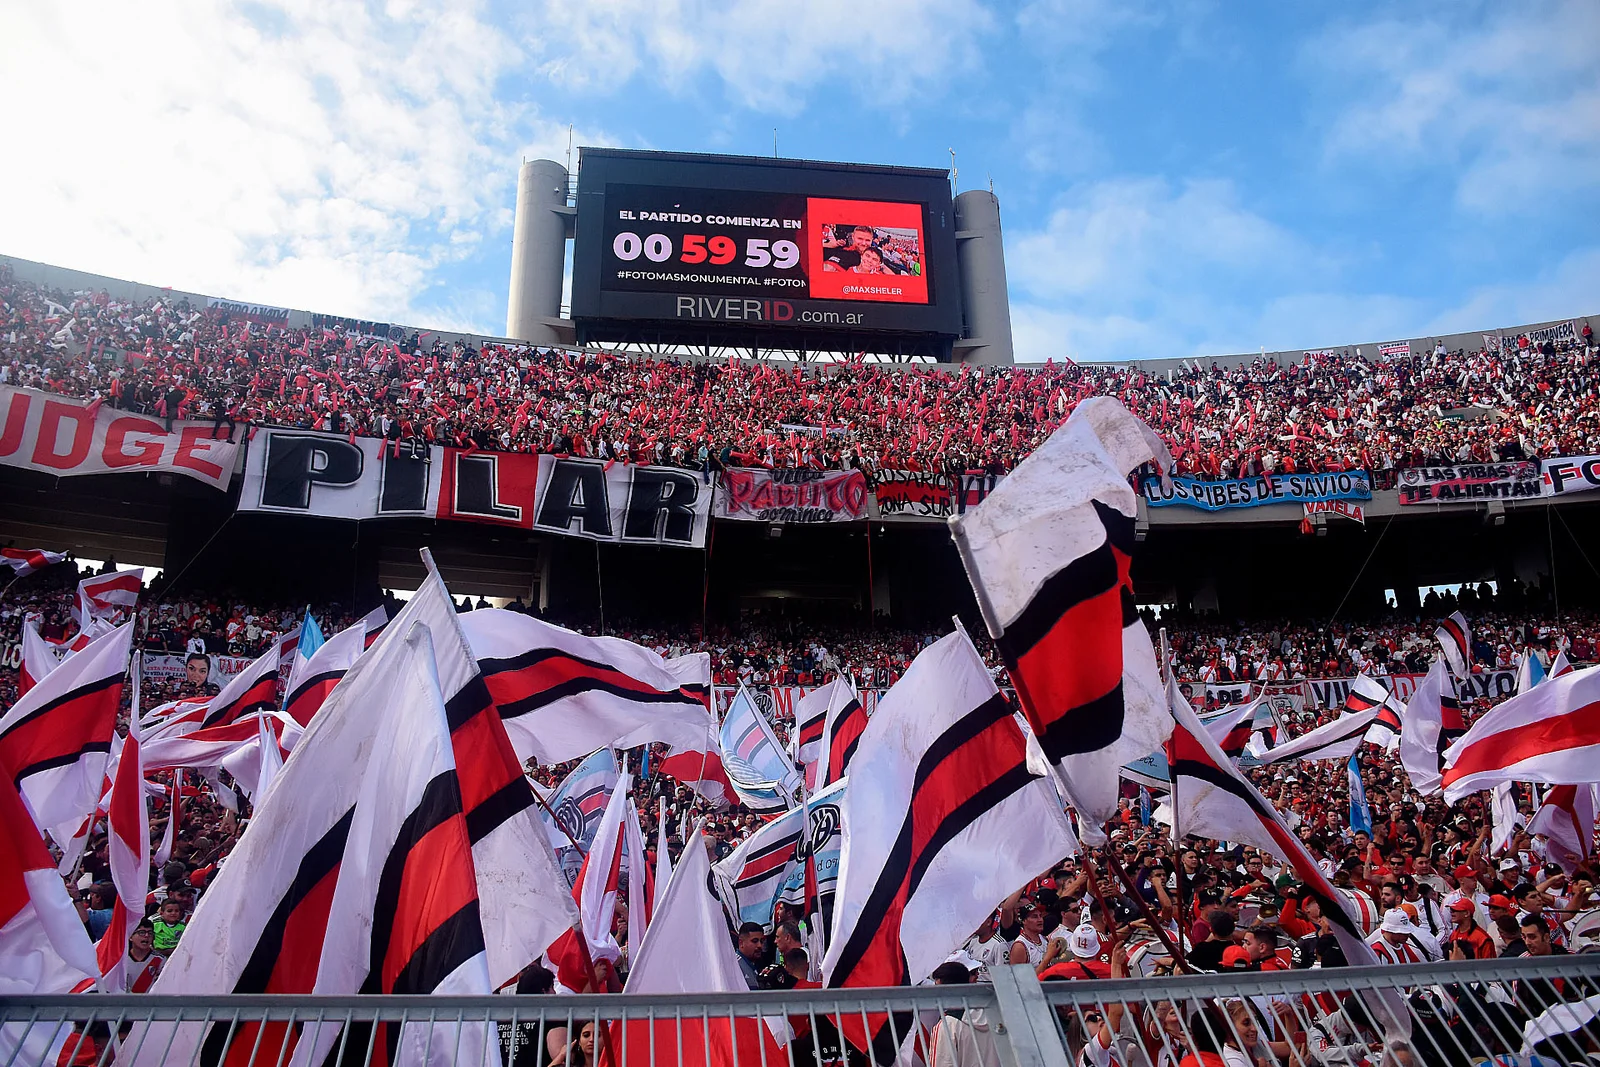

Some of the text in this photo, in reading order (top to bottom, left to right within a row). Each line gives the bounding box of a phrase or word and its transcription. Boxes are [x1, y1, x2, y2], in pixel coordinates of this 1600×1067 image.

[619, 210, 802, 229] EL PARTIDO COMIENZA EN
[613, 231, 800, 269] 00 59 59
[617, 271, 762, 286] #FOTOMASMONUMENTAL
[842, 285, 903, 296] @MAXSHELER
[1529, 321, 1576, 344] PRIMAVERA
[871, 469, 951, 493] ROSARIO
[1423, 467, 1457, 482] LAS
[1457, 463, 1511, 481] PIBAS
[258, 431, 699, 543] PILAR
[1145, 474, 1352, 508] LOS PIBES DE SAVIO
[1404, 480, 1542, 501] TE ALIENTAN
[918, 493, 955, 517] SUR
[1304, 499, 1363, 521] VARELA
[1217, 689, 1243, 704] DE
